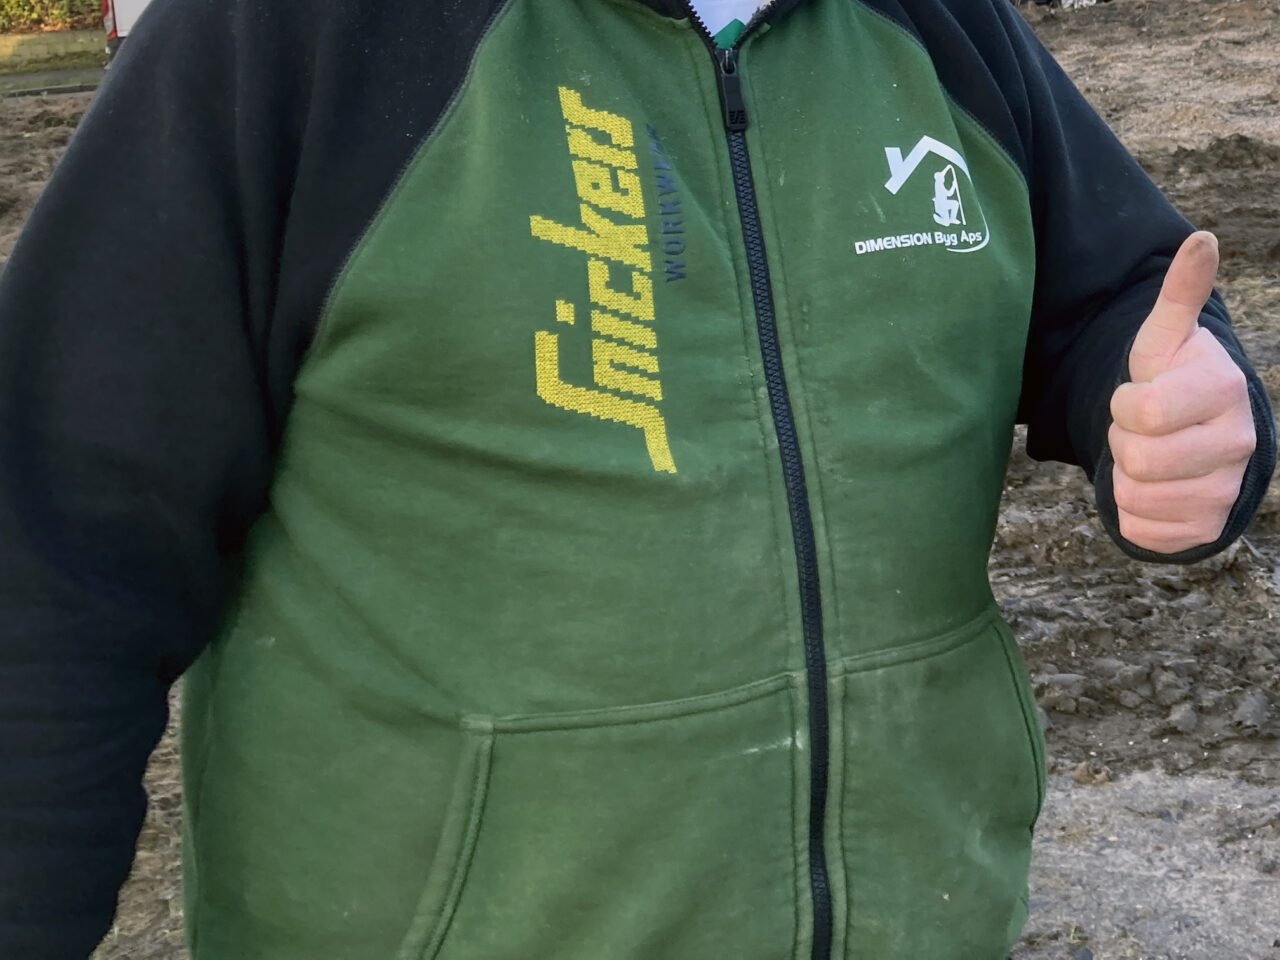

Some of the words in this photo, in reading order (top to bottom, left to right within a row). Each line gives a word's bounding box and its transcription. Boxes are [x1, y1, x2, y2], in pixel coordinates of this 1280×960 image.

[855, 232, 932, 254] DIMENSION
[935, 231, 958, 245] Byg
[961, 230, 982, 244] Aps
